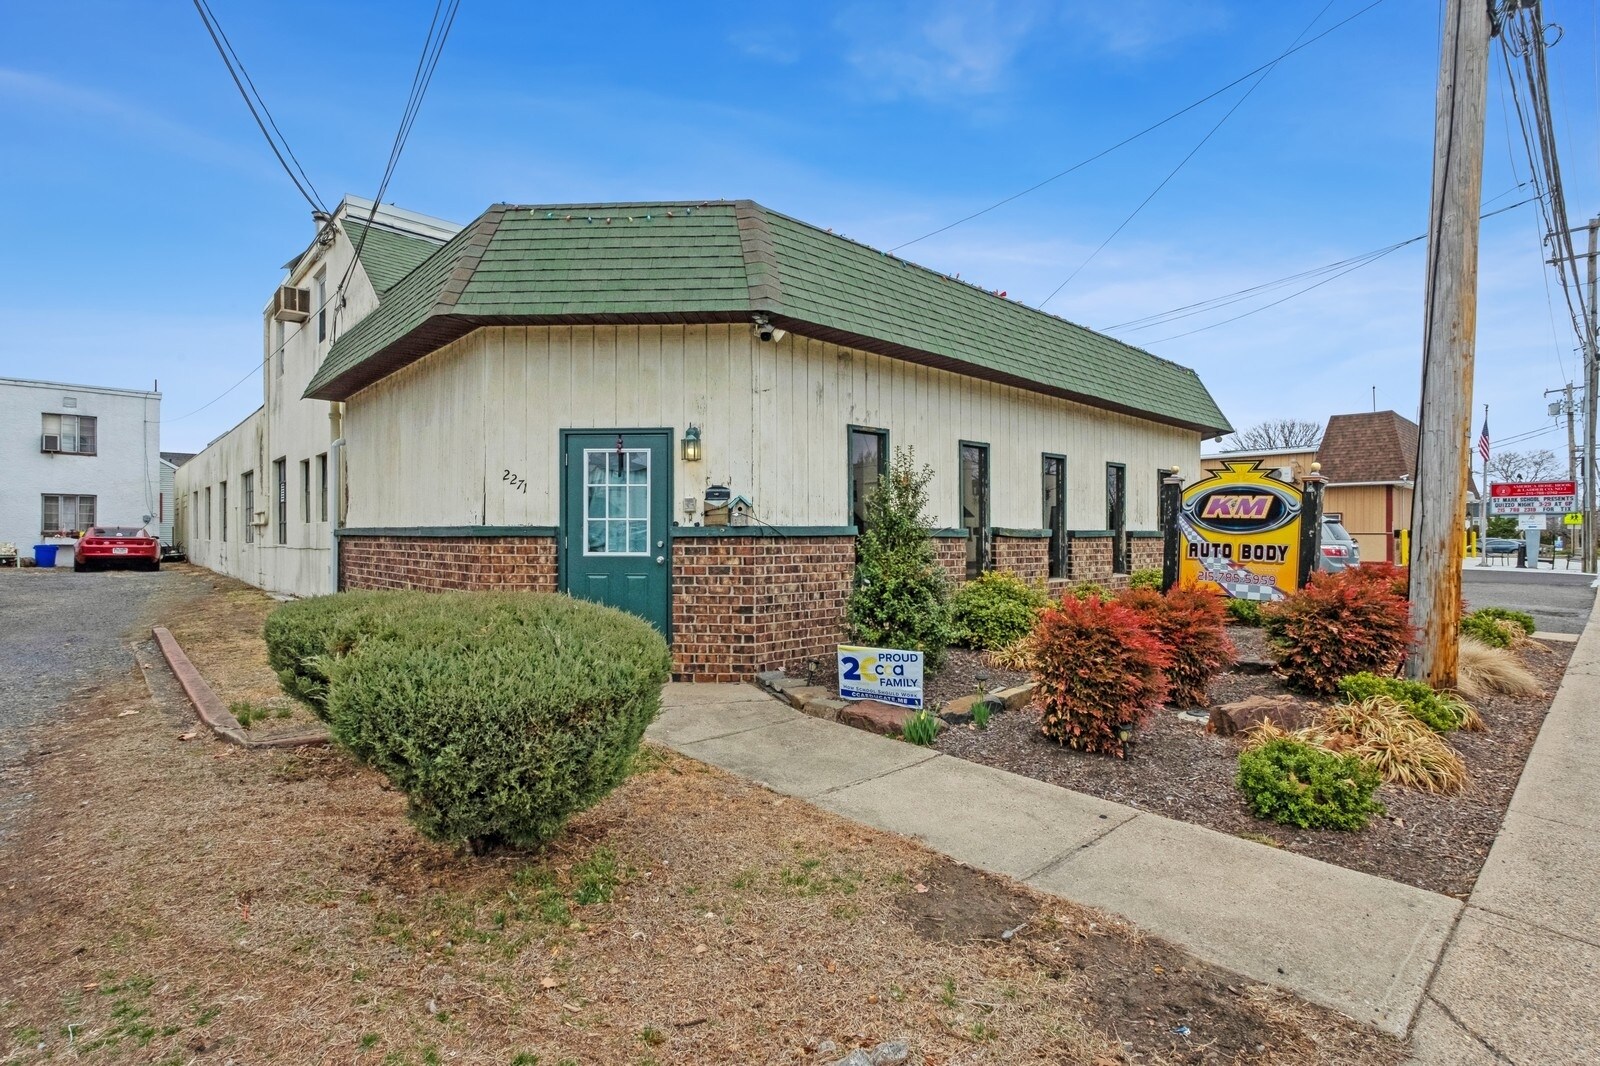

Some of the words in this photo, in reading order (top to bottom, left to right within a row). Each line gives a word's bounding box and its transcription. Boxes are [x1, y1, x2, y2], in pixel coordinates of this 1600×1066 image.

[503, 469, 527, 494] 2271
[1188, 542, 1232, 559] AUTO
[1241, 544, 1289, 562] BODY
[878, 653, 918, 662] PROUD
[880, 678, 918, 688] FAMILY
